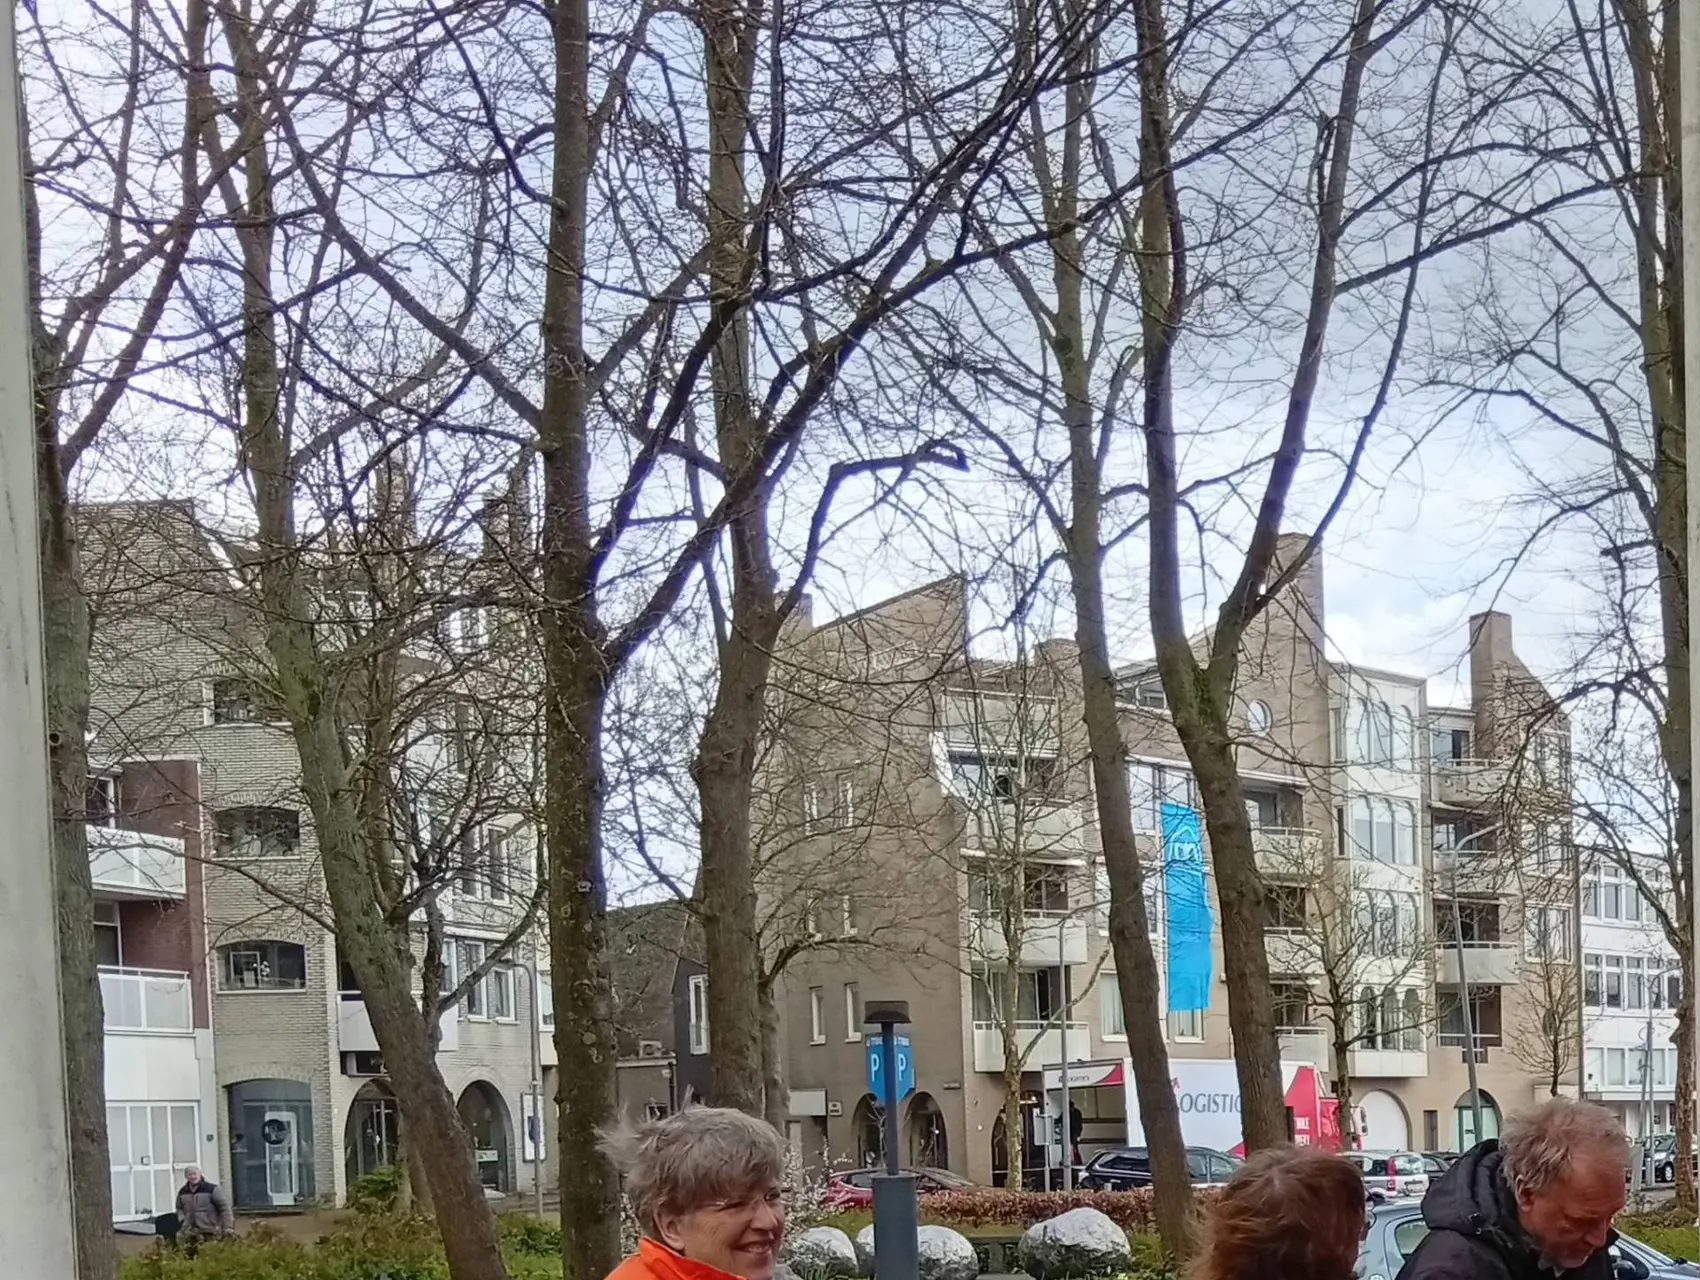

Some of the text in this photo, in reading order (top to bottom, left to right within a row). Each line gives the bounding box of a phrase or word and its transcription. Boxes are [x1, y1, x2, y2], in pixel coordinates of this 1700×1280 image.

[871, 1053, 880, 1082] P
[898, 1053, 907, 1081] P
[1180, 1092, 1242, 1114] OGISTIC
